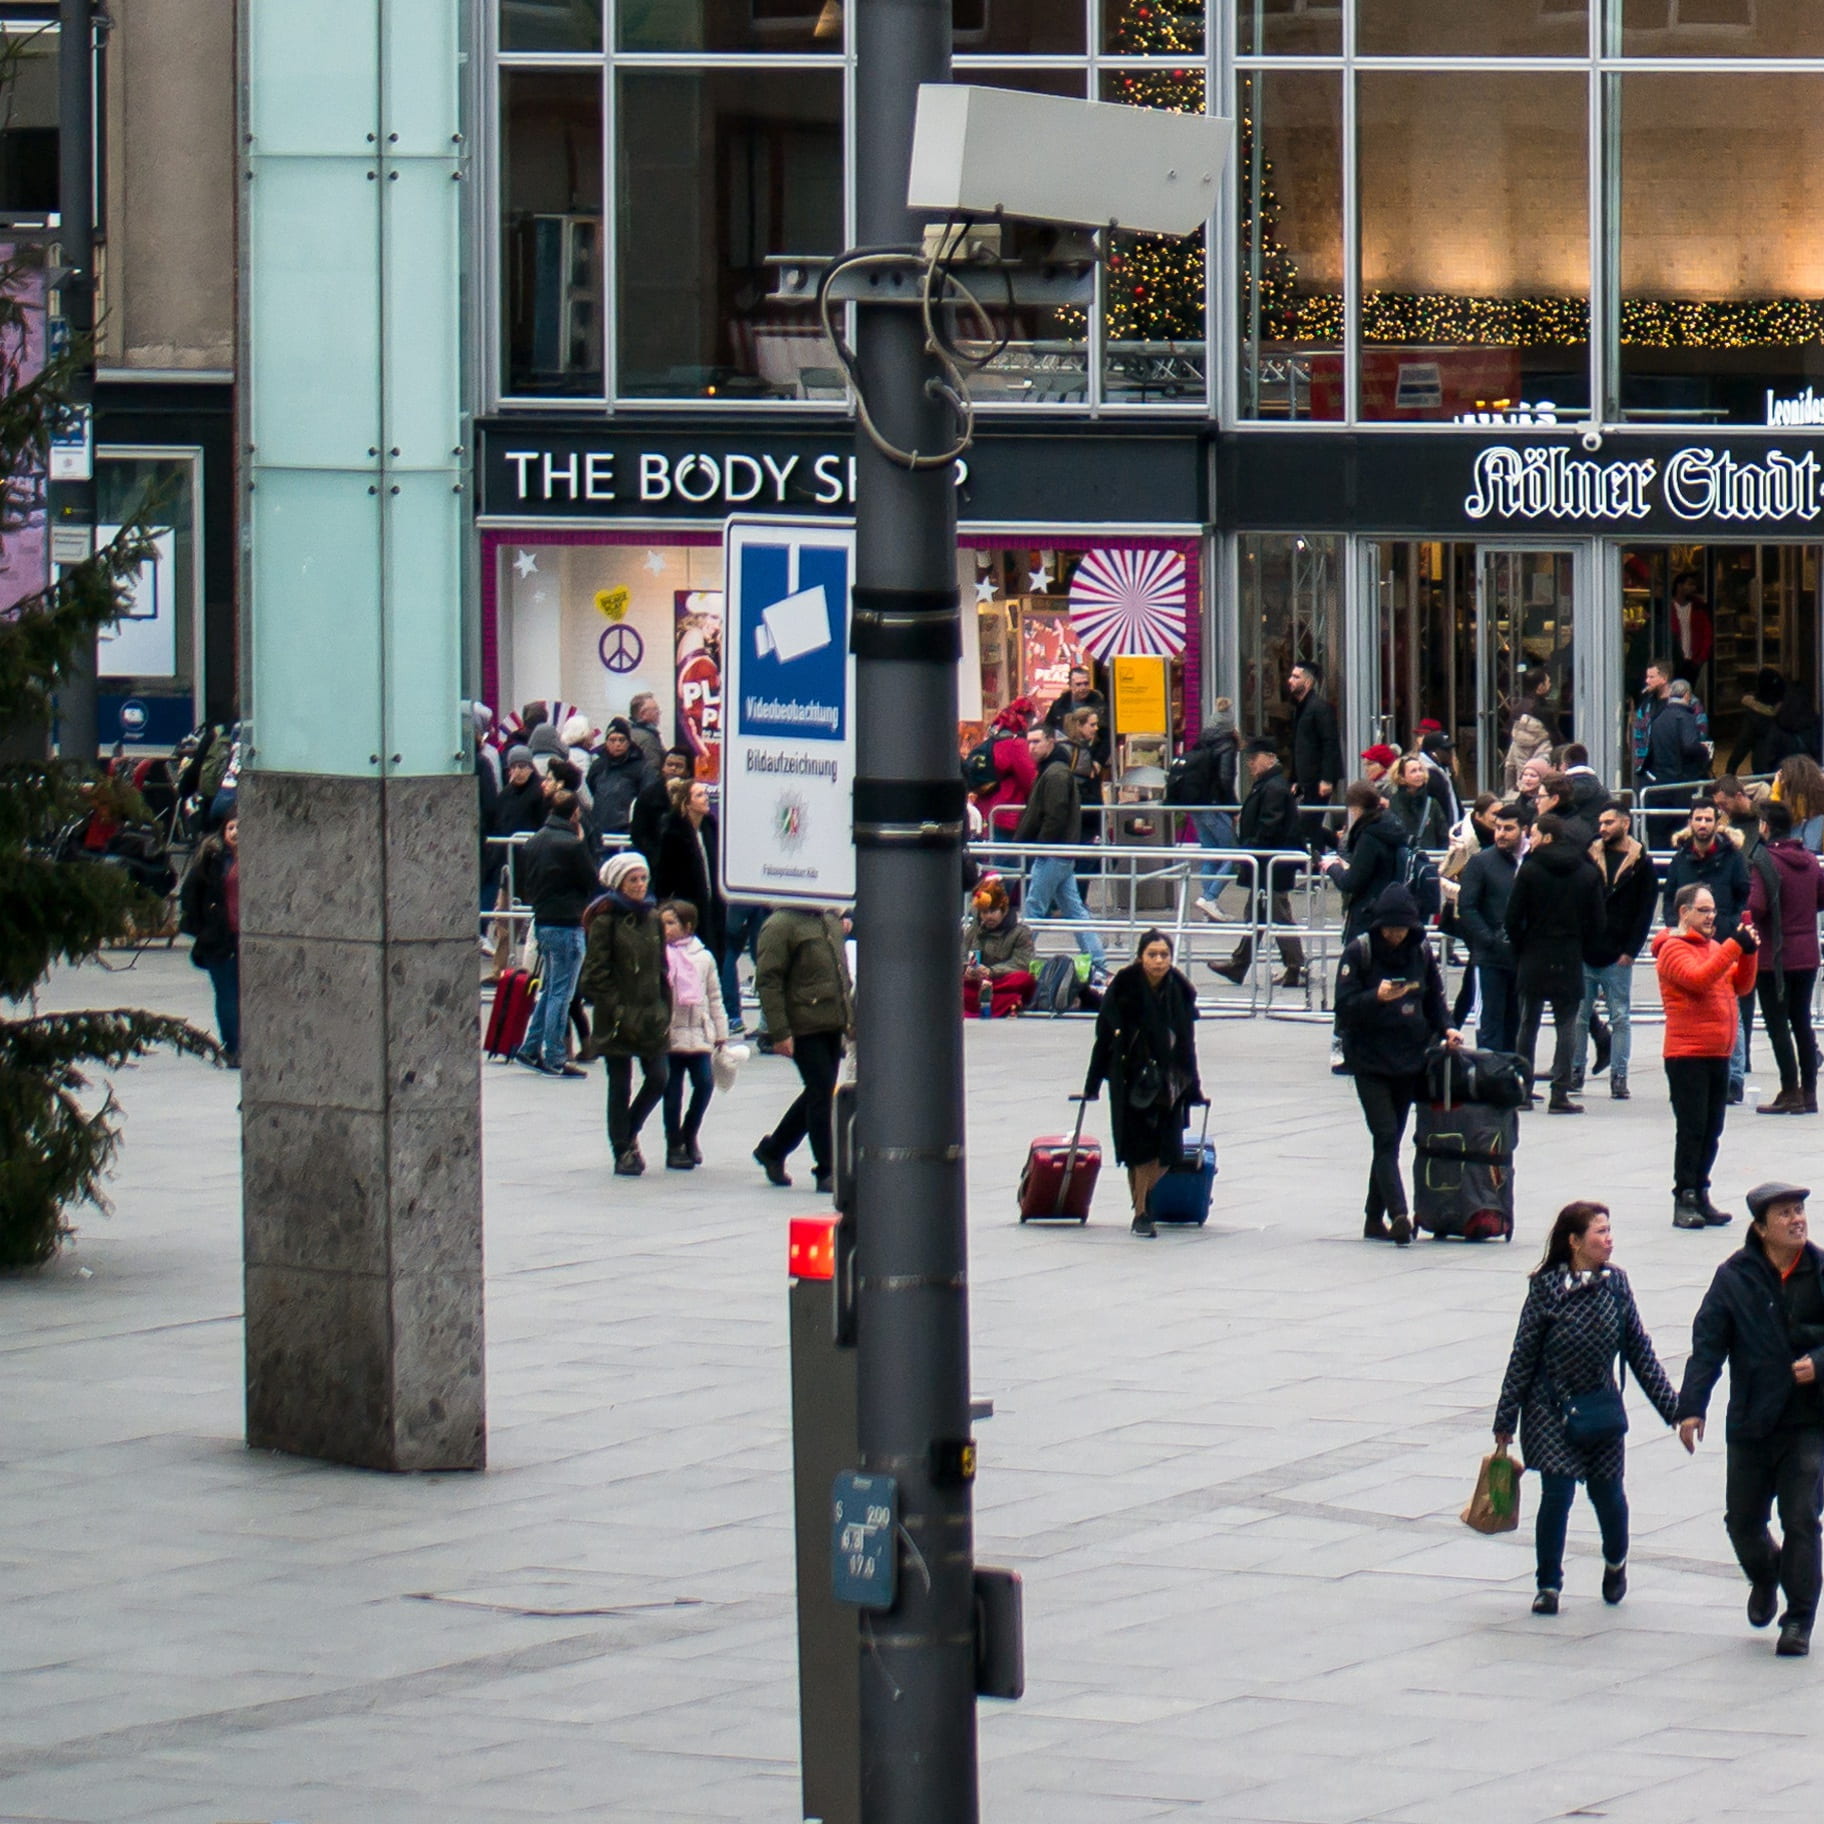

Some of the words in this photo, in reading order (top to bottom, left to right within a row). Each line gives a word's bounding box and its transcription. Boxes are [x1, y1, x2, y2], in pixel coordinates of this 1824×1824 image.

[504, 451, 616, 501] THE
[640, 452, 800, 502] BODY
[1465, 446, 1657, 519] Kölner
[745, 695, 839, 732] Videobeobachtung
[746, 748, 838, 783] Bildaufzeichnung
